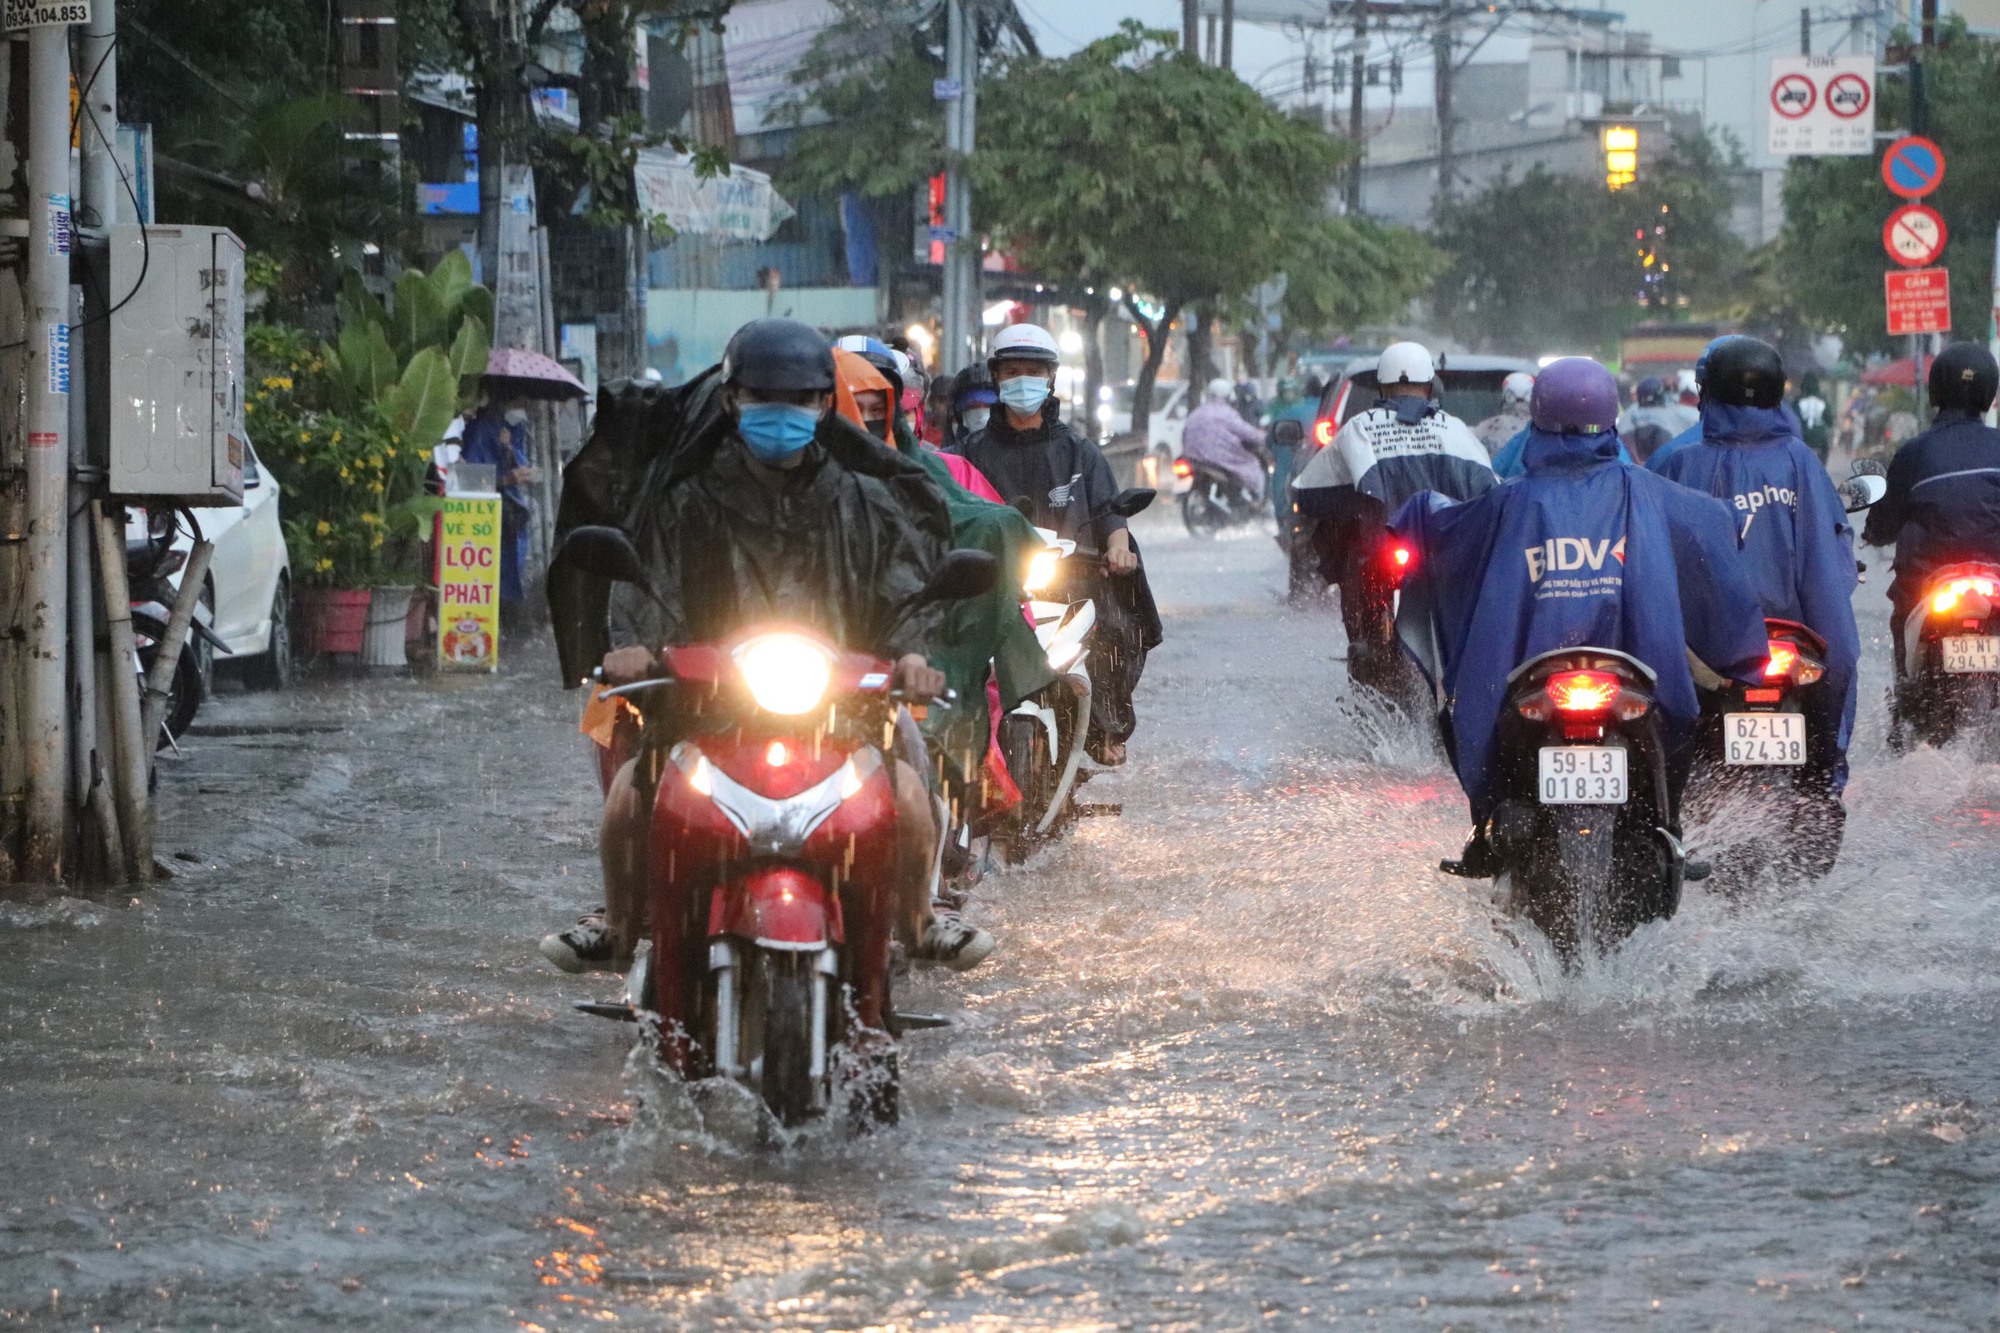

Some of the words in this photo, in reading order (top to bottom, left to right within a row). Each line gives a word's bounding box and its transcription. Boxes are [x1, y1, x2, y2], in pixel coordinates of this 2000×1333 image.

[6, 5, 87, 27] 0934.104.853
[446, 540, 493, 571] LỘC
[1525, 537, 1611, 583] BIDV
[444, 579, 494, 605] PHÁT
[1952, 639, 1991, 653] 50-N1
[1948, 655, 1999, 670] 294.13
[1737, 718, 1790, 738] 62-L1
[1731, 741, 1800, 760] 624.38
[1553, 752, 1613, 774] 59-L3
[1546, 777, 1620, 799] 018.33
